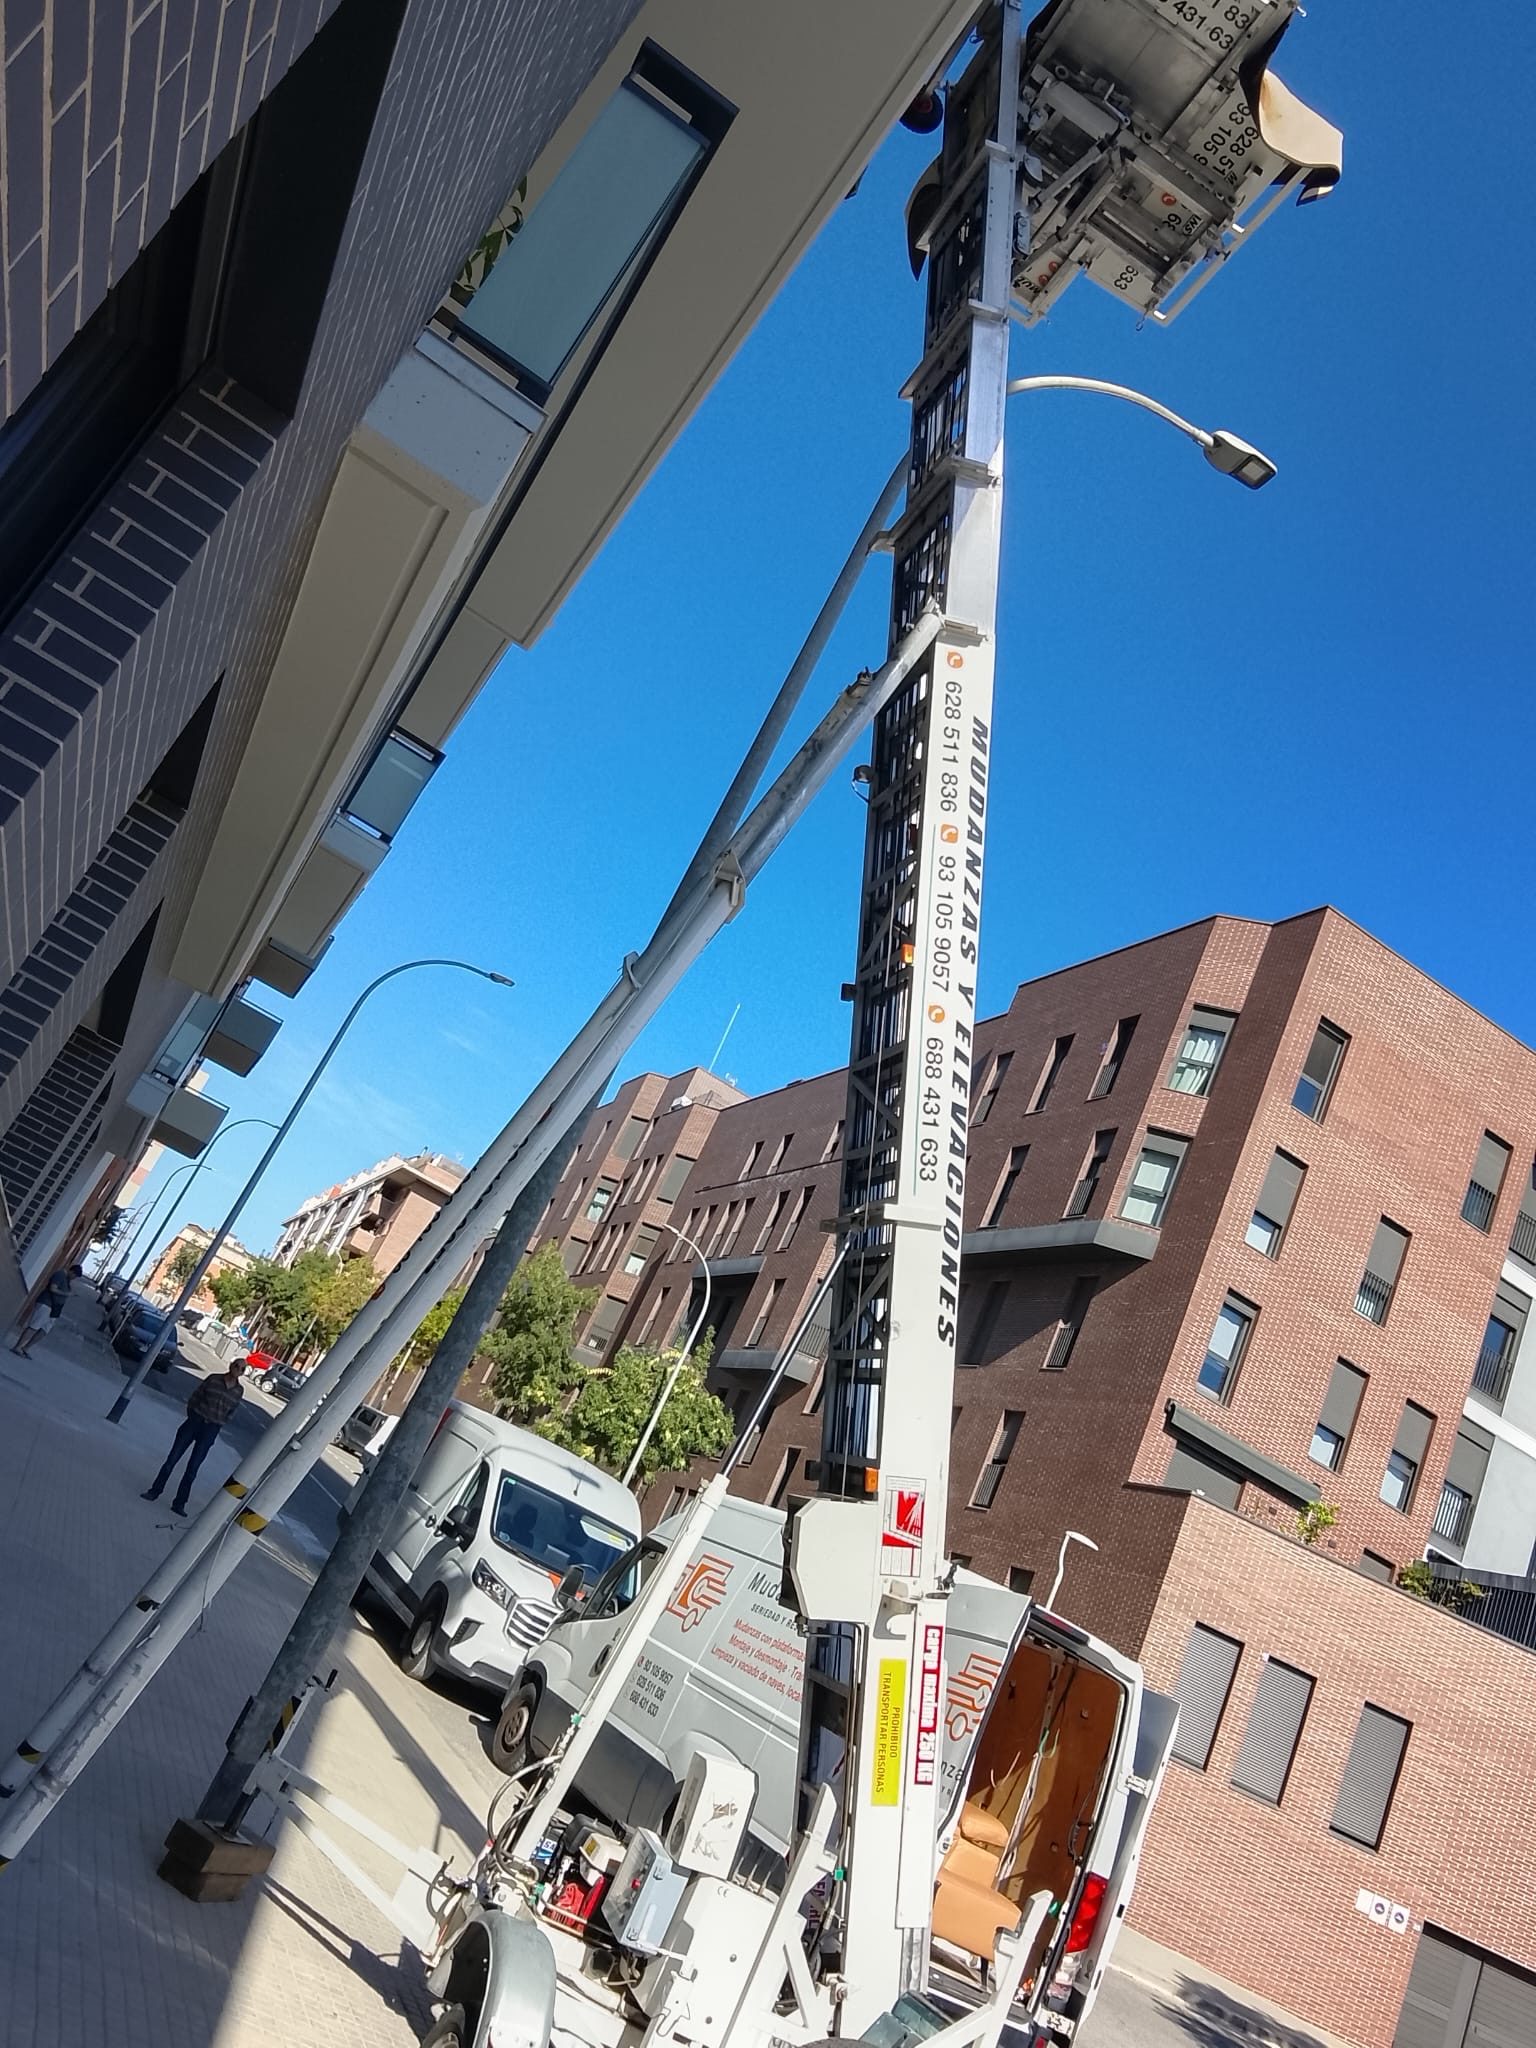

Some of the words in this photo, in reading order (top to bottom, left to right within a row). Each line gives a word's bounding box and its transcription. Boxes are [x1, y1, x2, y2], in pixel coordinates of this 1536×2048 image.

[1203, 126, 1232, 155] 105
[1229, 126, 1260, 156] 628
[1113, 264, 1139, 290] 633
[944, 680, 963, 720] 628
[941, 726, 961, 765] 511
[940, 772, 959, 813] 836
[958, 715, 989, 965] MUDANZAS
[938, 855, 956, 882] 93
[935, 892, 955, 930] 105
[932, 937, 952, 993] 9057
[957, 982, 974, 1009] Y
[924, 1036, 944, 1079] 688
[922, 1086, 941, 1129] 431
[919, 1138, 939, 1182] 633
[937, 1020, 972, 1349] ELEVACIONES
[734, 1617, 761, 1641] Mudanzas
[760, 1632, 773, 1645] con
[750, 1602, 781, 1623] SERIEDAD
[711, 1642, 735, 1665] Limpieza
[728, 1633, 751, 1655] Montaje
[753, 1646, 788, 1674] desmontaje
[923, 1627, 942, 1671] carga
[879, 1672, 892, 1740] TRANSPORTAR
[920, 1672, 939, 1729] maxima
[889, 1707, 901, 1759] PROHIBIDO
[918, 1731, 936, 1760] 250
[875, 1742, 888, 1793] PERSONAS
